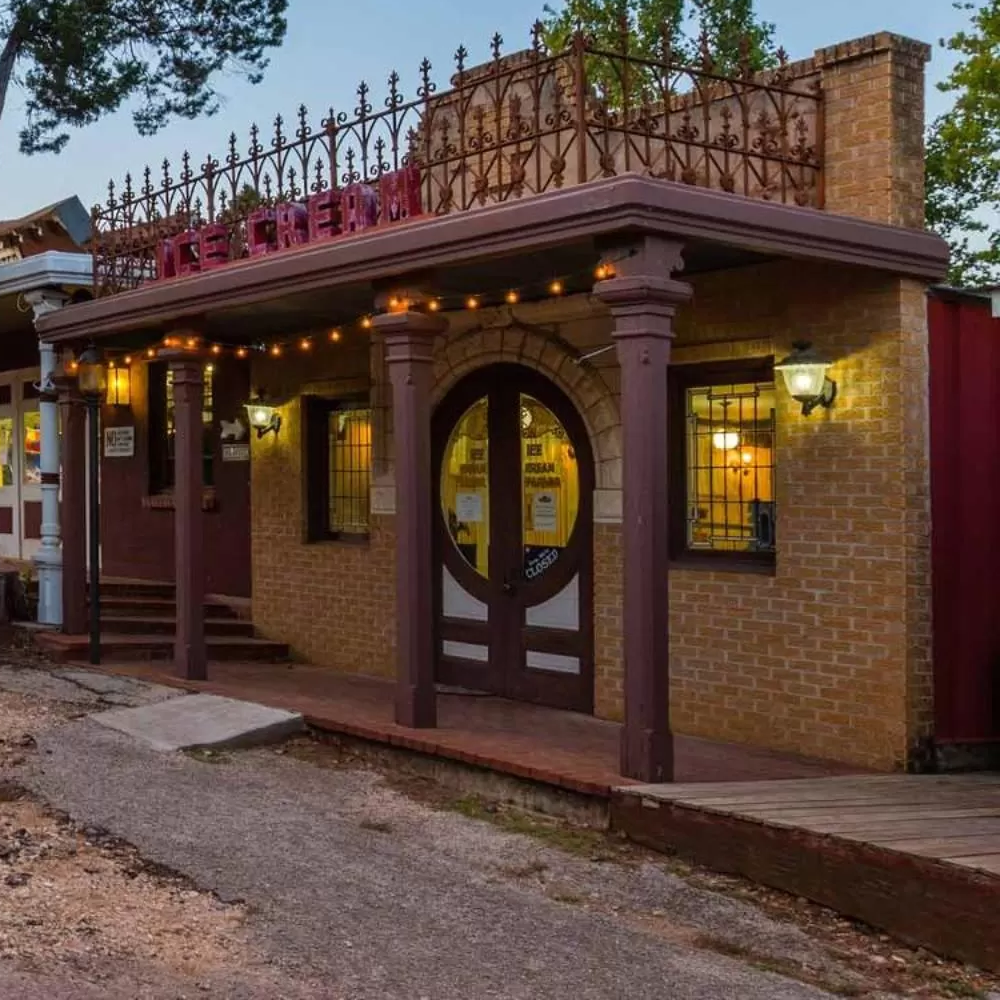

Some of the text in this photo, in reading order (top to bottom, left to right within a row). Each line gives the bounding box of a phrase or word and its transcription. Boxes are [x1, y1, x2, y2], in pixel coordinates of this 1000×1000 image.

[158, 166, 421, 279] ICE CREAM
[525, 548, 558, 578] CLOSED
